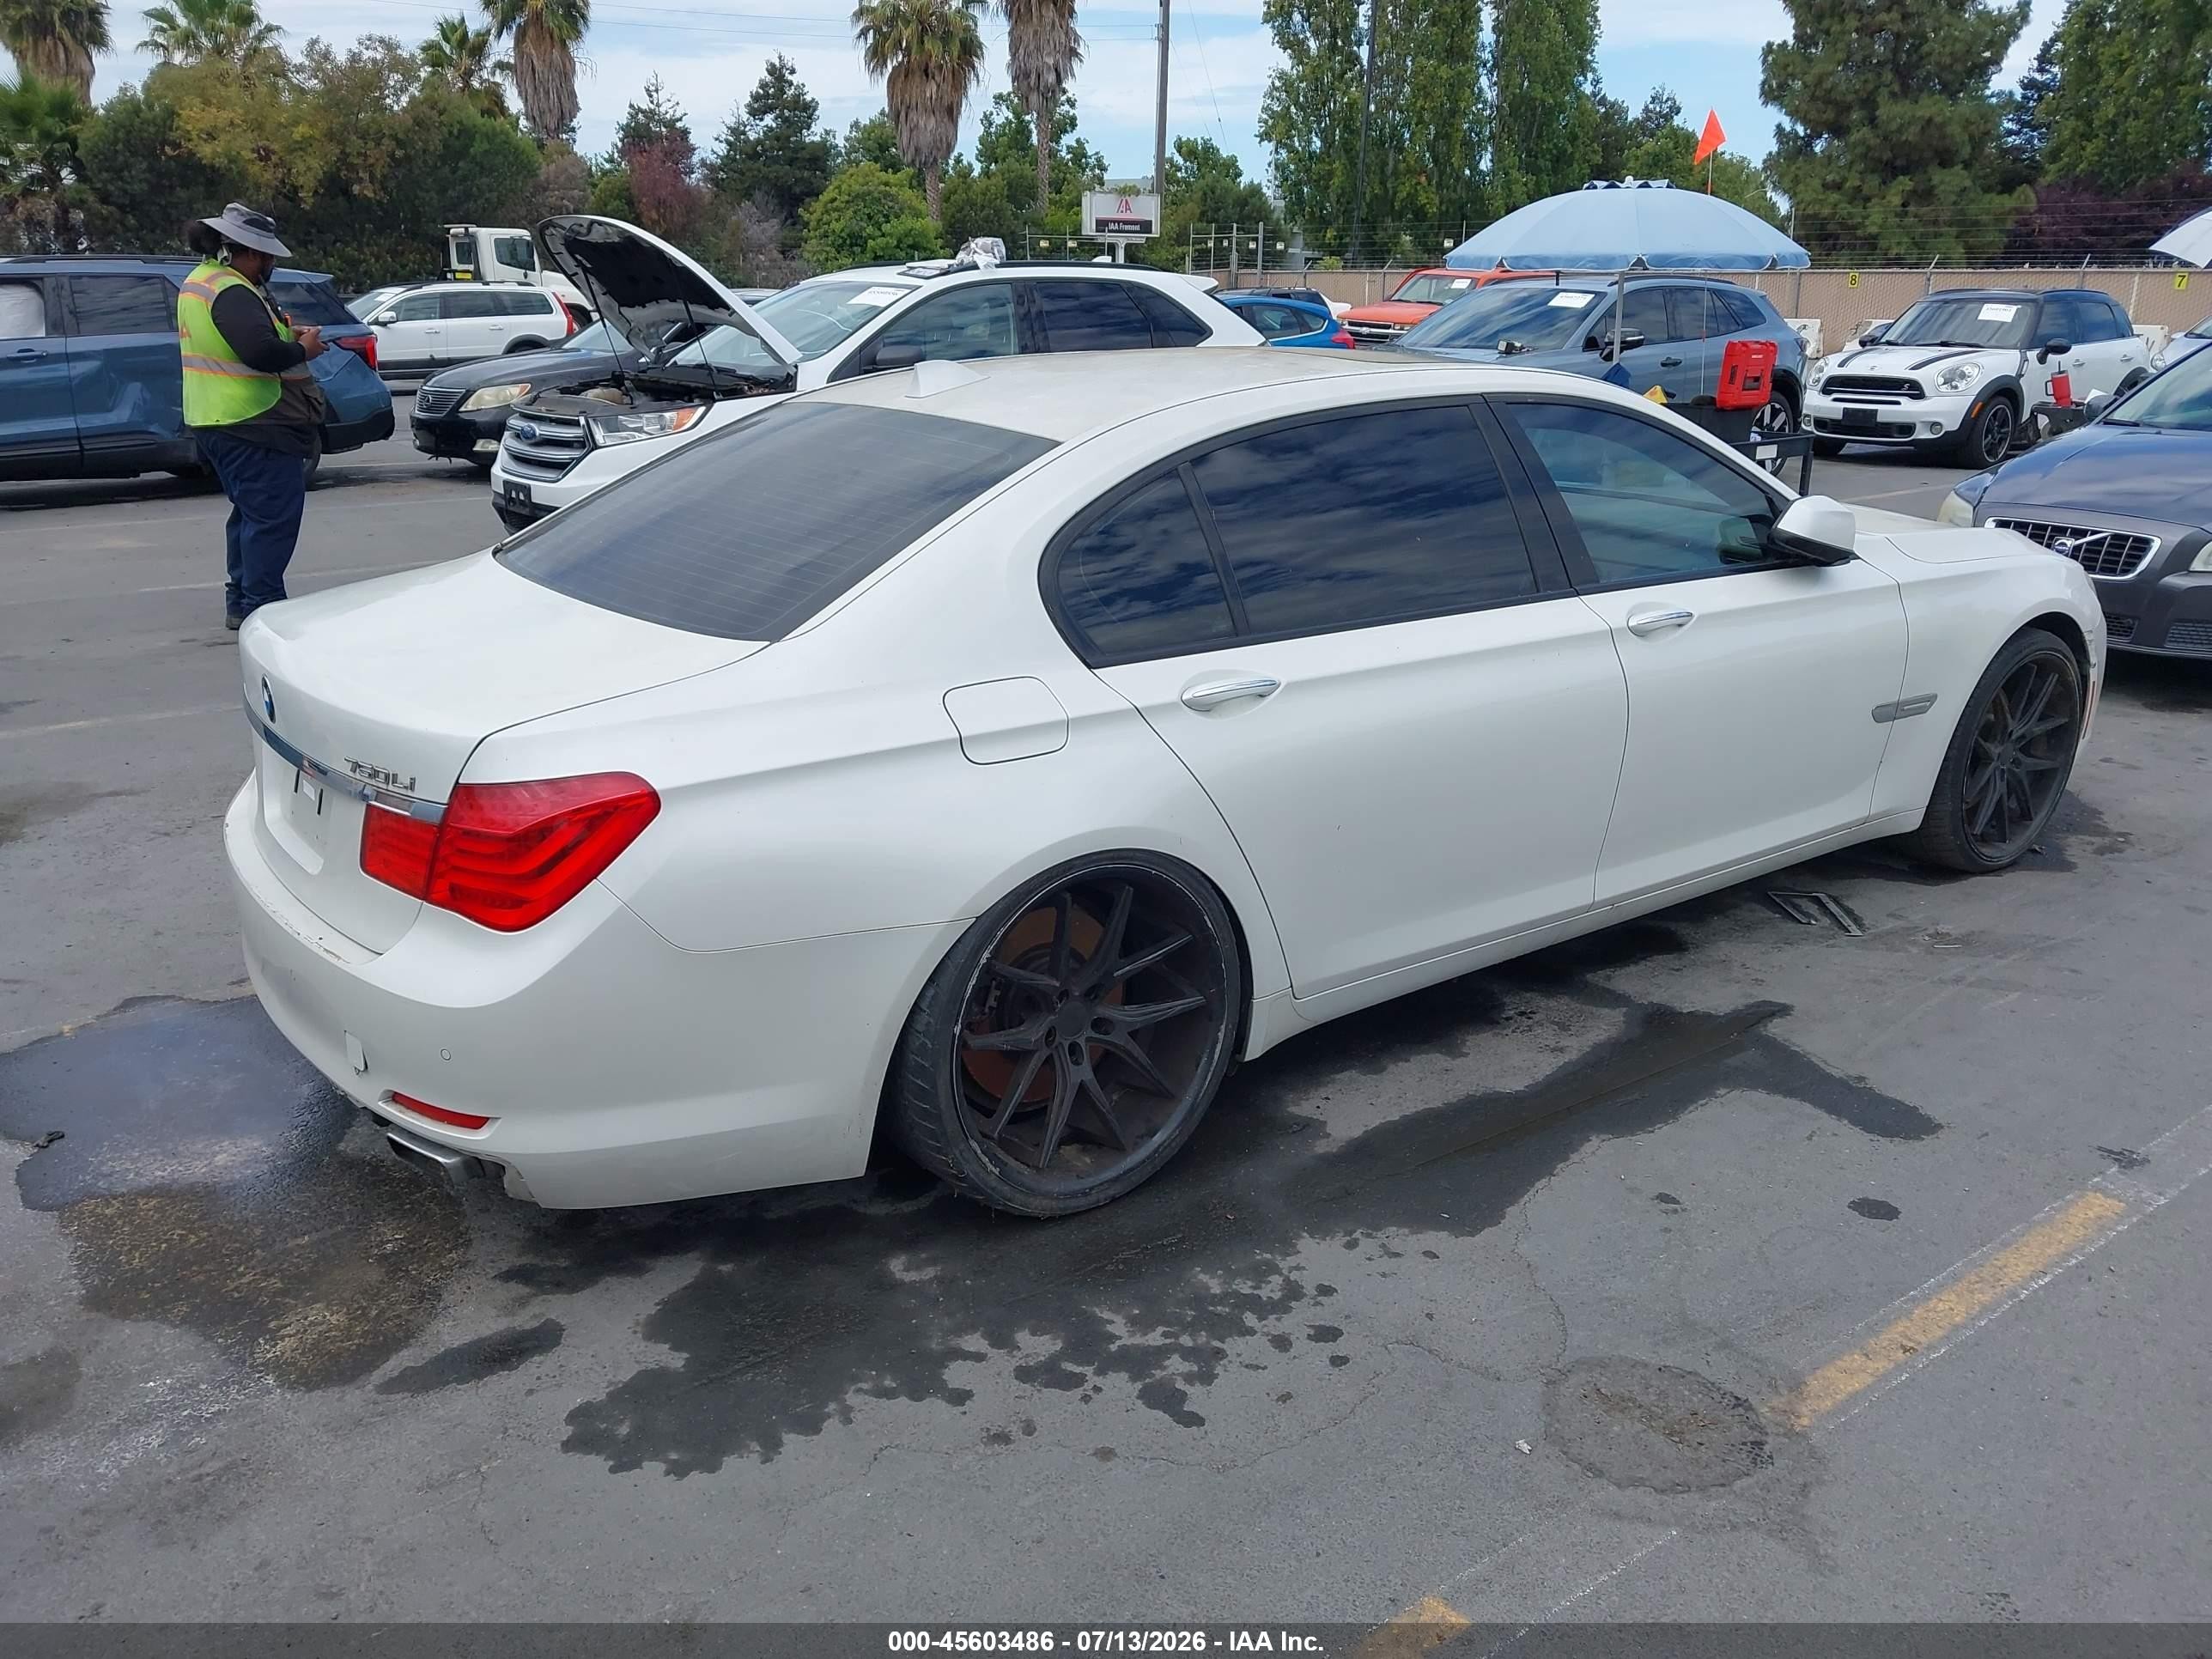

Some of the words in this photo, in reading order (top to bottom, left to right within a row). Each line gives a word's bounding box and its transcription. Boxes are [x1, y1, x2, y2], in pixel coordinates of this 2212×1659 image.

[1109, 222, 1119, 231] IAA
[1850, 274, 1857, 286] 8
[2177, 274, 2187, 289] 7
